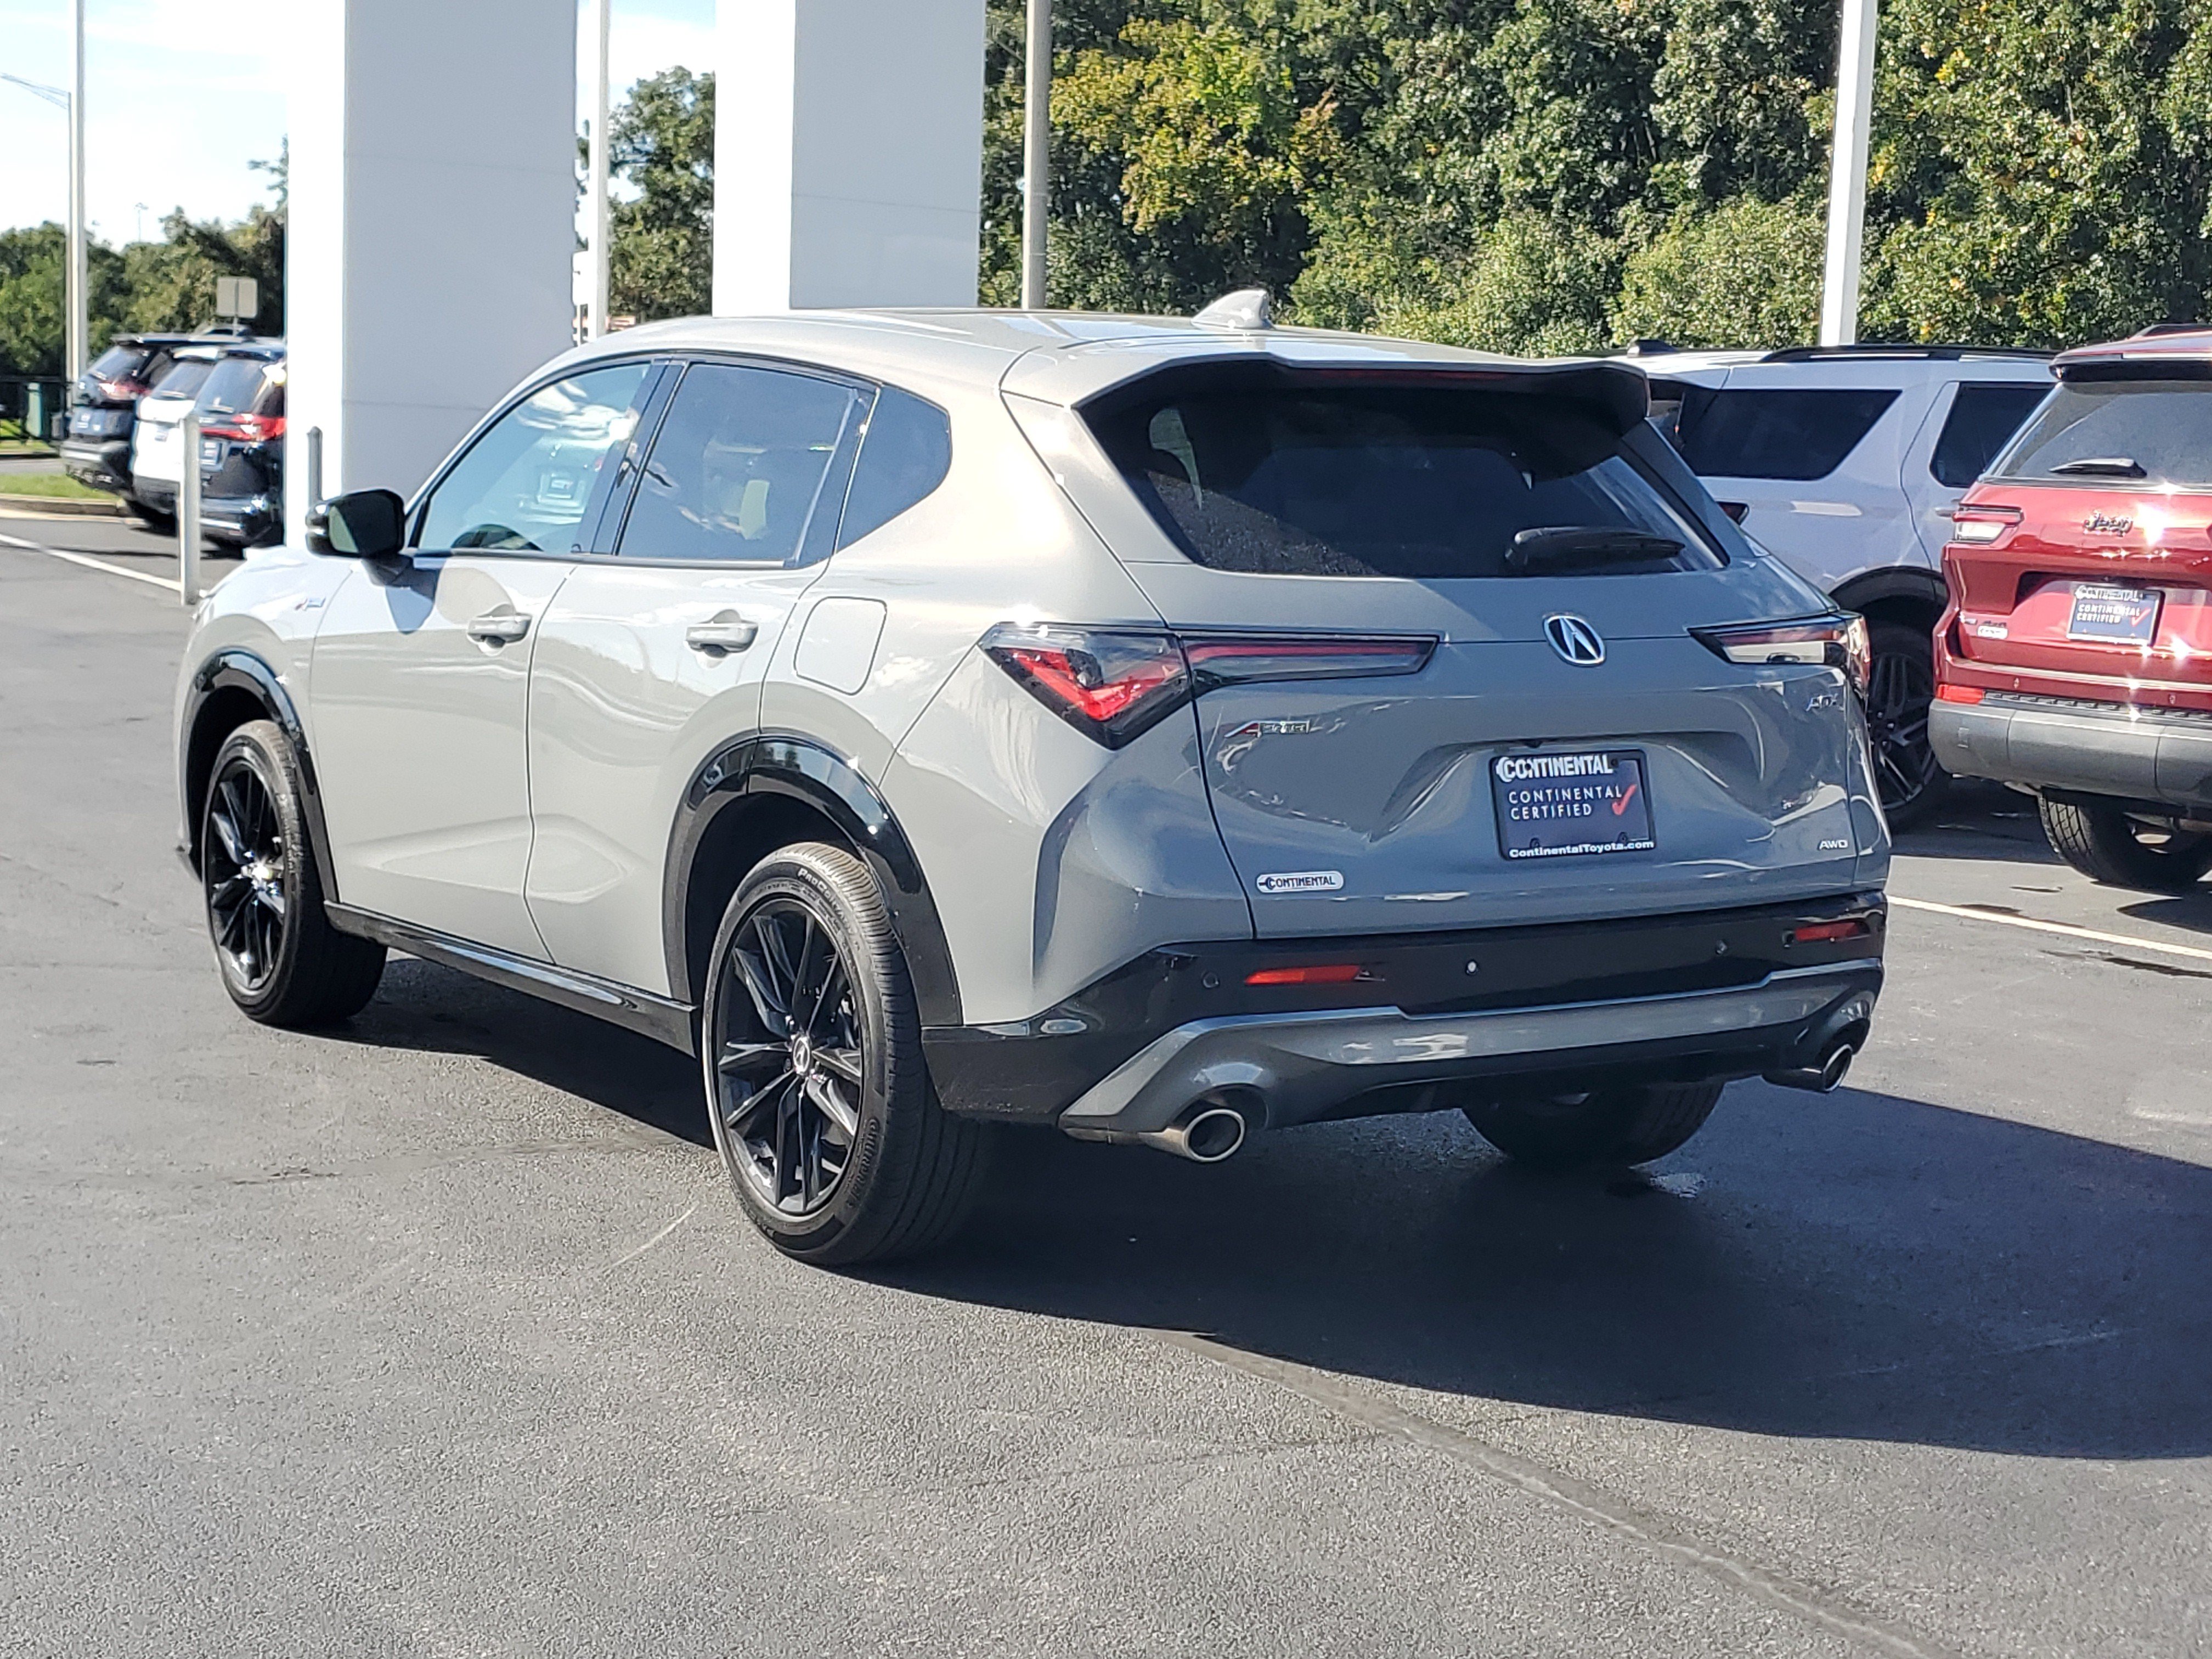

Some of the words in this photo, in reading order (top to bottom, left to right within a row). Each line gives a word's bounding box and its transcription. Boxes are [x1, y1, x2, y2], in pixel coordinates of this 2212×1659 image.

[1496, 754, 1613, 782] CONTINENTAL
[1509, 785, 1622, 804] CONTINENTAL
[1511, 803, 1592, 820] CERTIFIED
[1509, 841, 1654, 857] ContinentalToyota.com
[1819, 839, 1848, 850] AWD
[1265, 876, 1336, 890] CONTINENTAL
